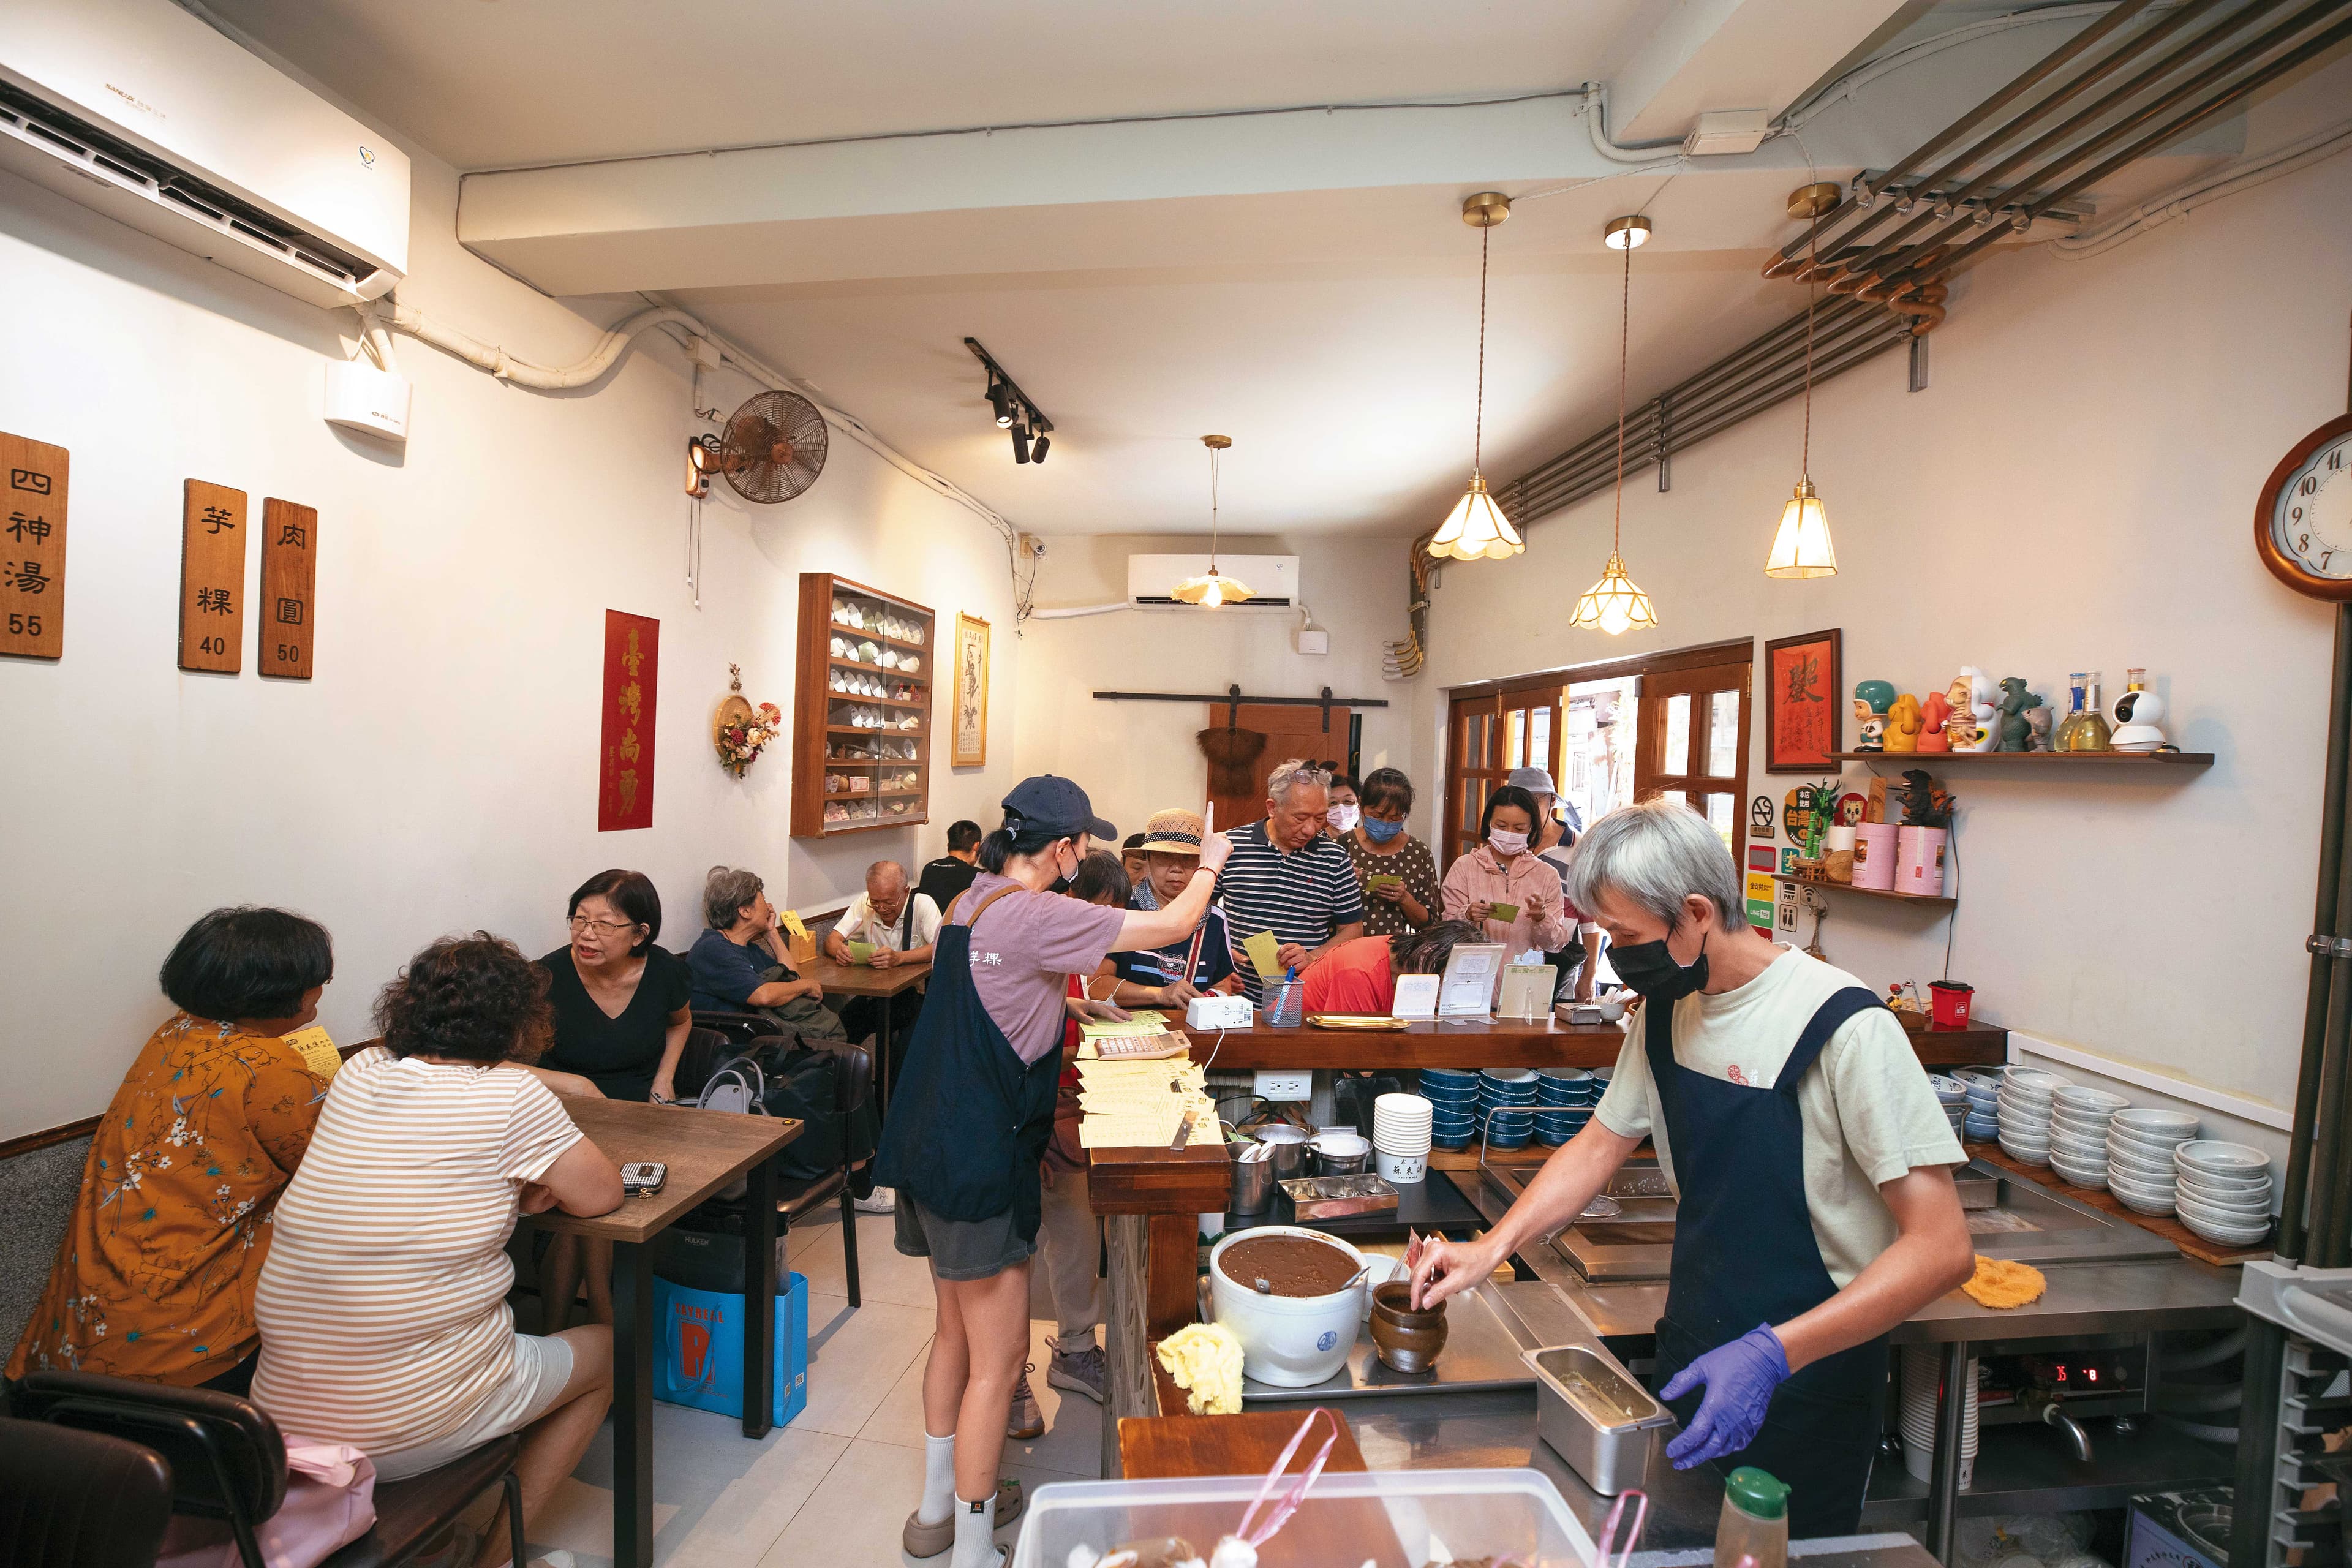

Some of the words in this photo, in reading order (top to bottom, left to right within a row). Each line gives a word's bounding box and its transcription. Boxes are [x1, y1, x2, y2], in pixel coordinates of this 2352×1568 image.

[106, 83, 135, 102] SANLUX
[2327, 449, 2342, 470] 11
[2299, 476, 2317, 496] 10
[2291, 507, 2303, 526] 9
[5, 468, 51, 594] 四神湯
[2298, 533, 2309, 552] 8
[197, 506, 235, 616] 芋粿
[2321, 551, 2334, 570] 7
[276, 524, 306, 625] 肉圓
[9, 613, 42, 636] 55
[200, 636, 225, 655] 40
[277, 644, 299, 663] 50
[1790, 832, 1806, 846] TAIWAN
[1750, 882, 1763, 891] 全支付
[968, 950, 1002, 967] 芋粿
[676, 1303, 724, 1324] TAYREAL
